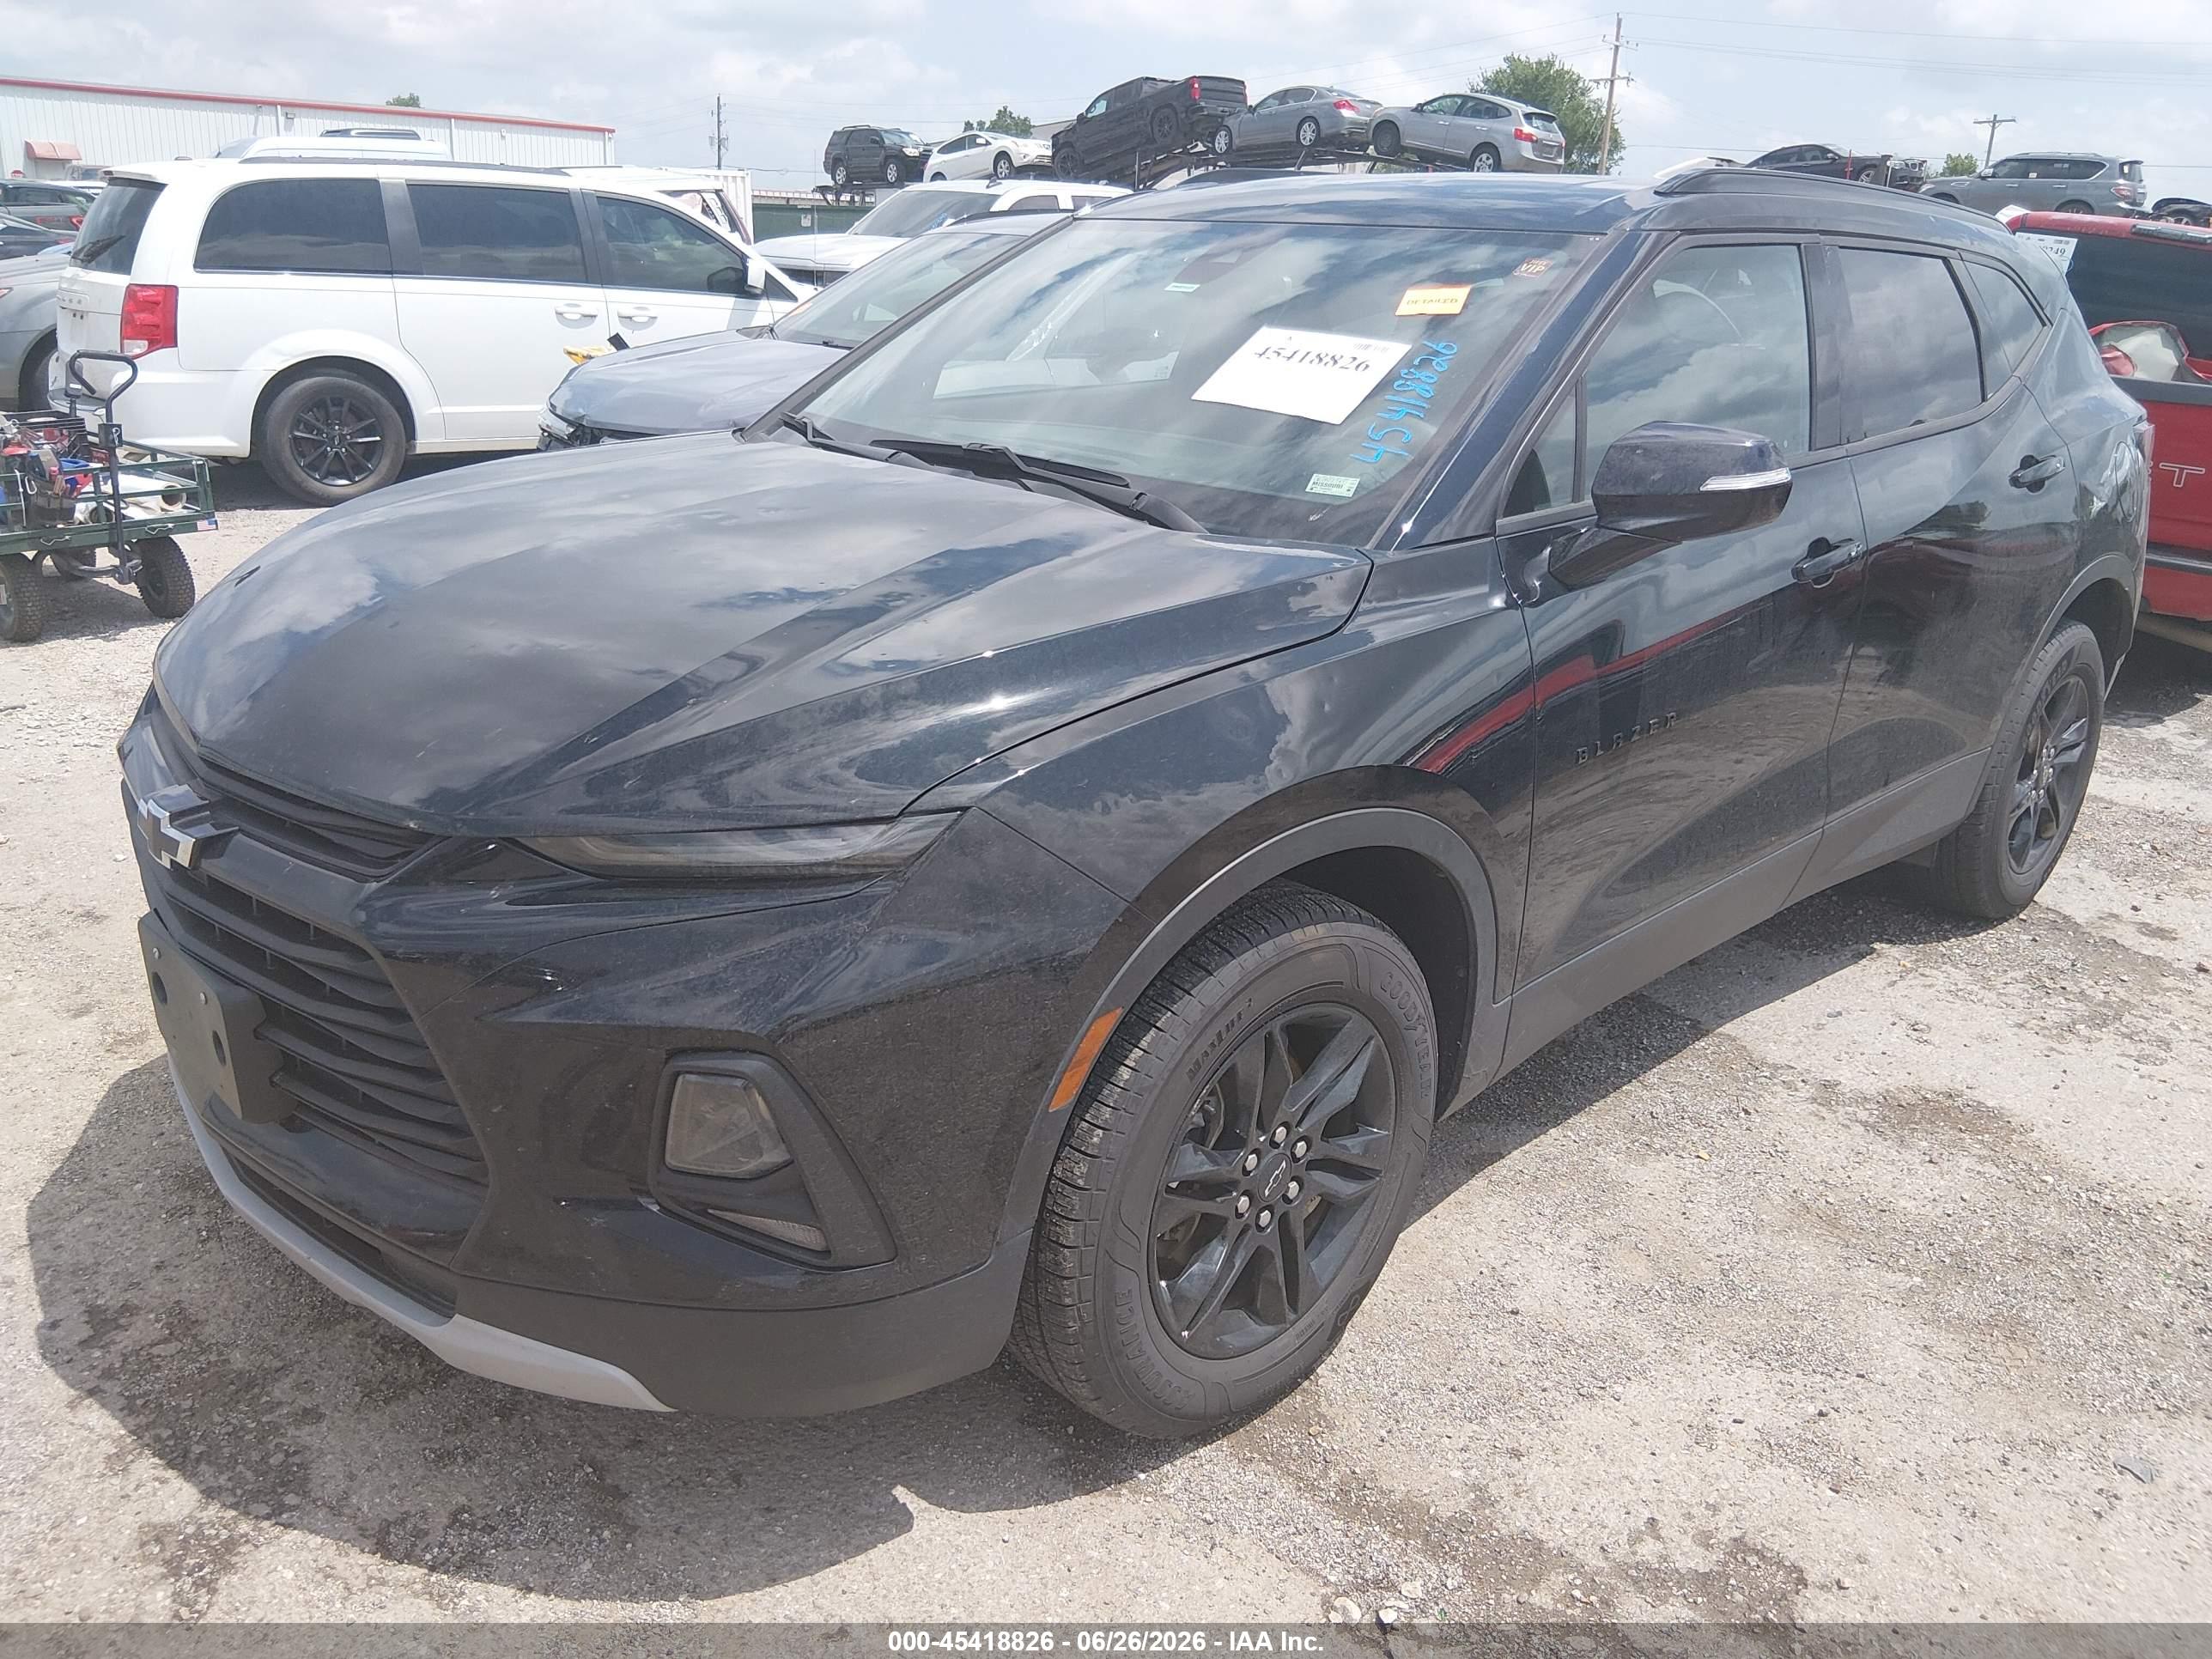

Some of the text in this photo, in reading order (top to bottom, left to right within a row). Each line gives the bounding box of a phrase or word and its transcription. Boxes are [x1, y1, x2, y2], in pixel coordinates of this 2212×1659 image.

[1521, 263, 1546, 273] VIP
[1255, 345, 1370, 373] 45418826
[1576, 712, 1677, 764] BLAZER
